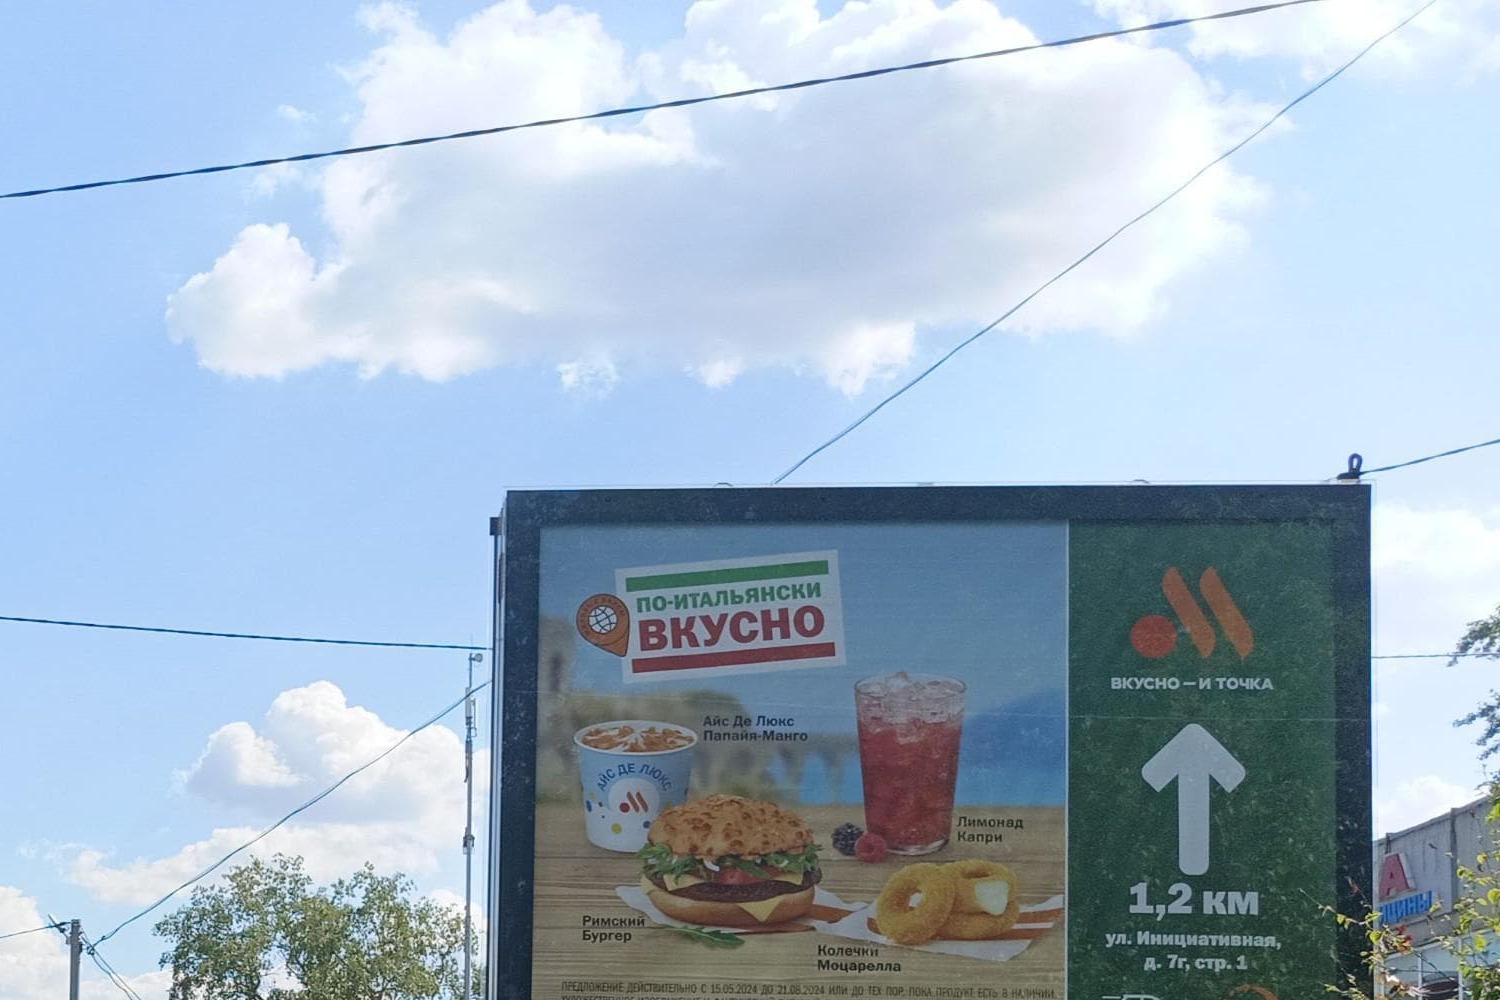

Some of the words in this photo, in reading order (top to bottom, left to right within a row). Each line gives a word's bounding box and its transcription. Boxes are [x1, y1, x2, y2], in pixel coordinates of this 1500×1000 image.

[636, 582, 821, 613] ПО-ИТАЛЬЯНСКИ
[638, 605, 825, 651] ВКУСНО
[1111, 677, 1180, 690] ВКУСНО
[1199, 678, 1211, 690] И
[1216, 678, 1274, 690] ТОЧКА
[703, 715, 729, 727] Айс
[733, 715, 751, 729] Де
[757, 715, 794, 727] Люкс
[703, 730, 808, 742] Папайя-Манго
[597, 768, 615, 791] АЙС
[618, 763, 635, 776] ДЕ
[639, 765, 672, 792] ЛЮКС
[956, 816, 1024, 829] Лимонад
[957, 831, 1003, 844] Капри
[1129, 882, 1193, 921] 1,2
[582, 915, 645, 927] Римский
[582, 930, 632, 943] Бургер
[1105, 933, 1132, 947] ул.
[1137, 931, 1281, 950] Инициативная,
[817, 945, 879, 956] Колечки
[817, 960, 901, 973] Моцарелла
[1144, 957, 1161, 971] д.
[1167, 955, 1190, 972] 7г,
[1195, 958, 1232, 974] стр.
[1236, 955, 1248, 970] 1
[626, 982, 697, 994] ДЕЙСТВИТЕЛЬНО
[701, 984, 707, 994] С
